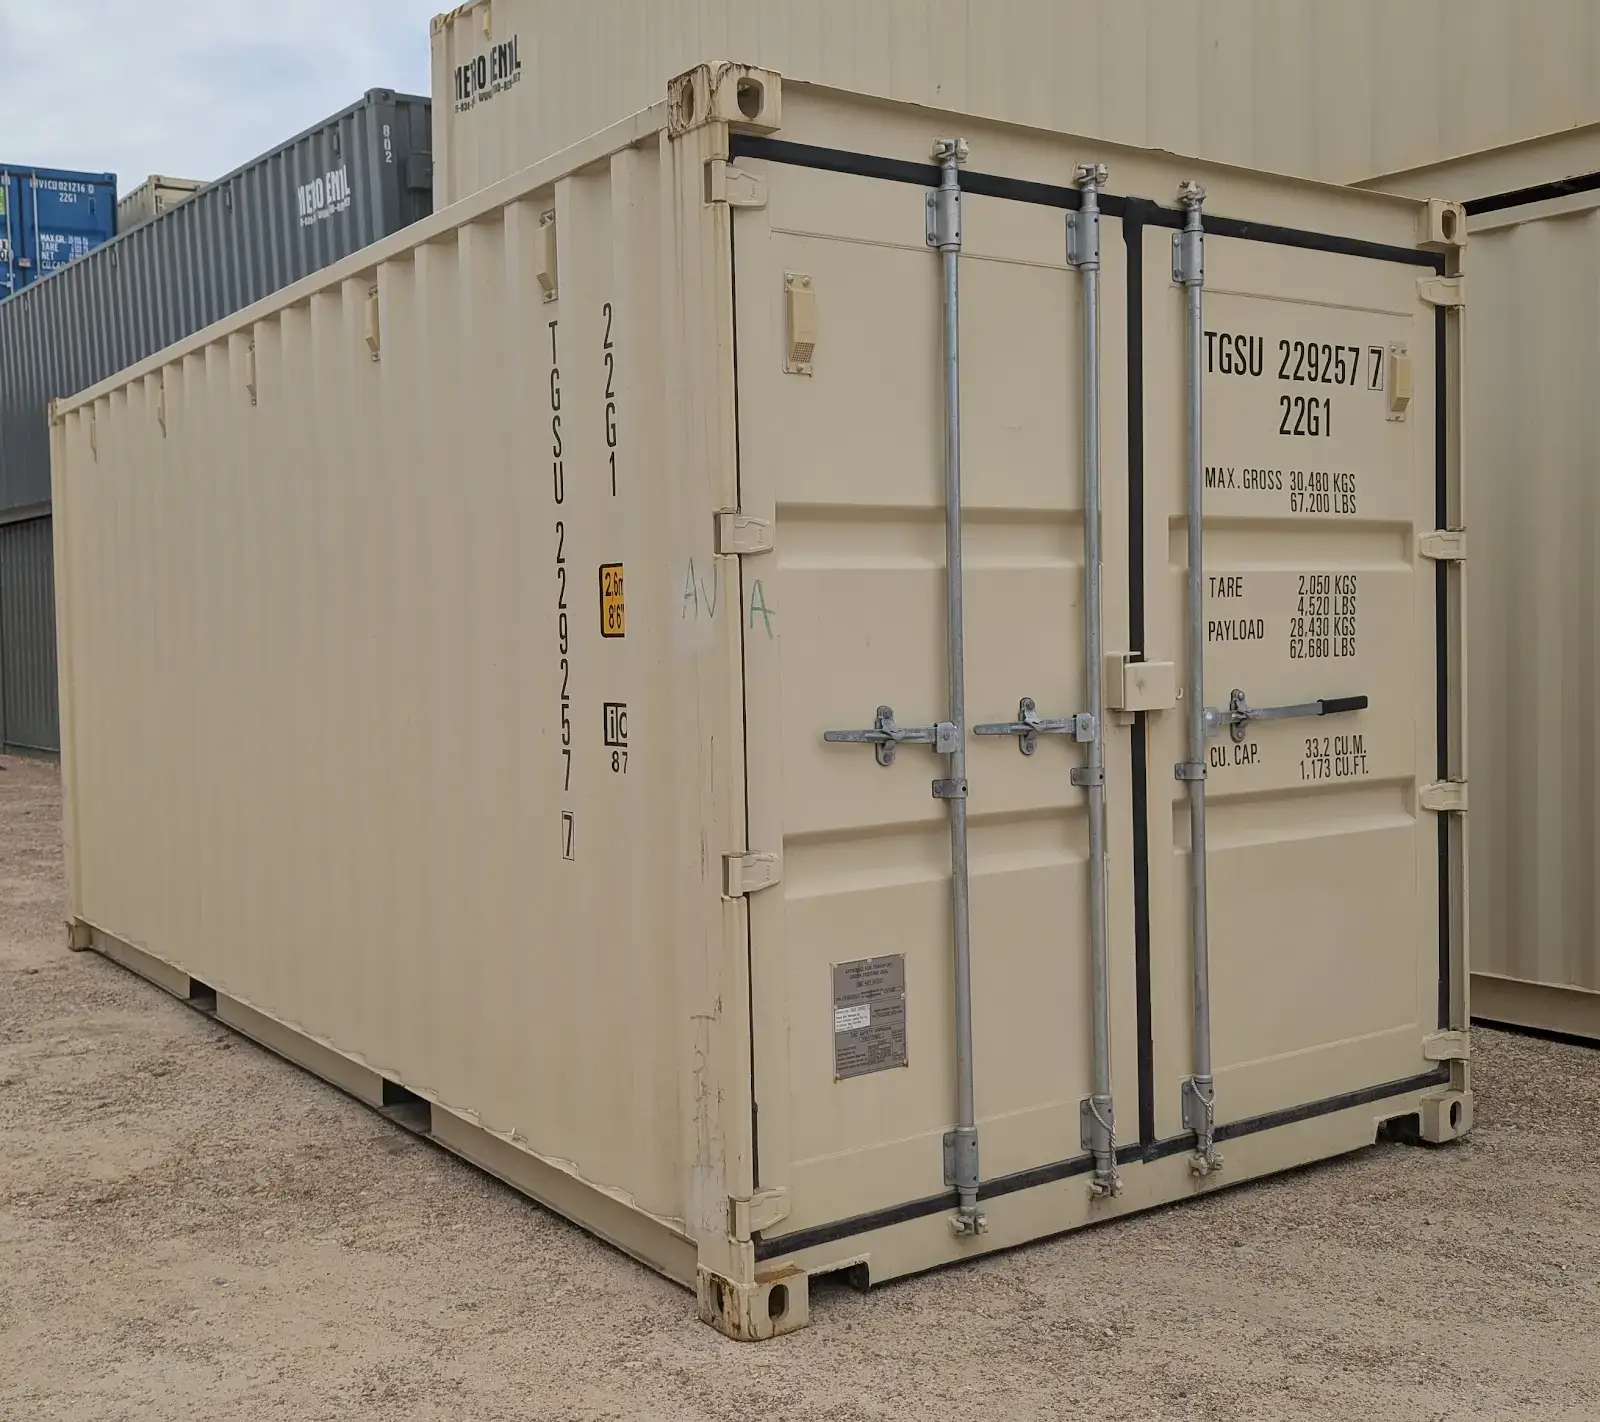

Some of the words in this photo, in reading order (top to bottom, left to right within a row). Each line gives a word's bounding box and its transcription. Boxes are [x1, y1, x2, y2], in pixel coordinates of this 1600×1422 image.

[58, 180, 85, 193] 021216
[59, 193, 77, 203] 22G1
[1204, 331, 1263, 377] TGSU
[1278, 339, 1360, 386] 229257
[1370, 347, 1383, 389] 7
[549, 320, 564, 504] TGSU
[603, 302, 617, 497] 22G1
[1279, 395, 1331, 437] 22G1
[1333, 473, 1356, 493] KGS
[1334, 494, 1357, 513] LBS
[1209, 576, 1243, 598] TARE
[1334, 575, 1357, 595] KGS
[1334, 596, 1356, 616] LBS
[1208, 618, 1265, 642] PAYLOAD
[1333, 616, 1356, 636] KGS
[556, 521, 571, 791] 229257
[1333, 637, 1356, 657] LBS
[611, 750, 628, 774] 87
[1210, 746, 1231, 768] CU.
[1234, 743, 1261, 765] CAP.
[1305, 738, 1330, 758] 33.2
[563, 812, 573, 859] 7
